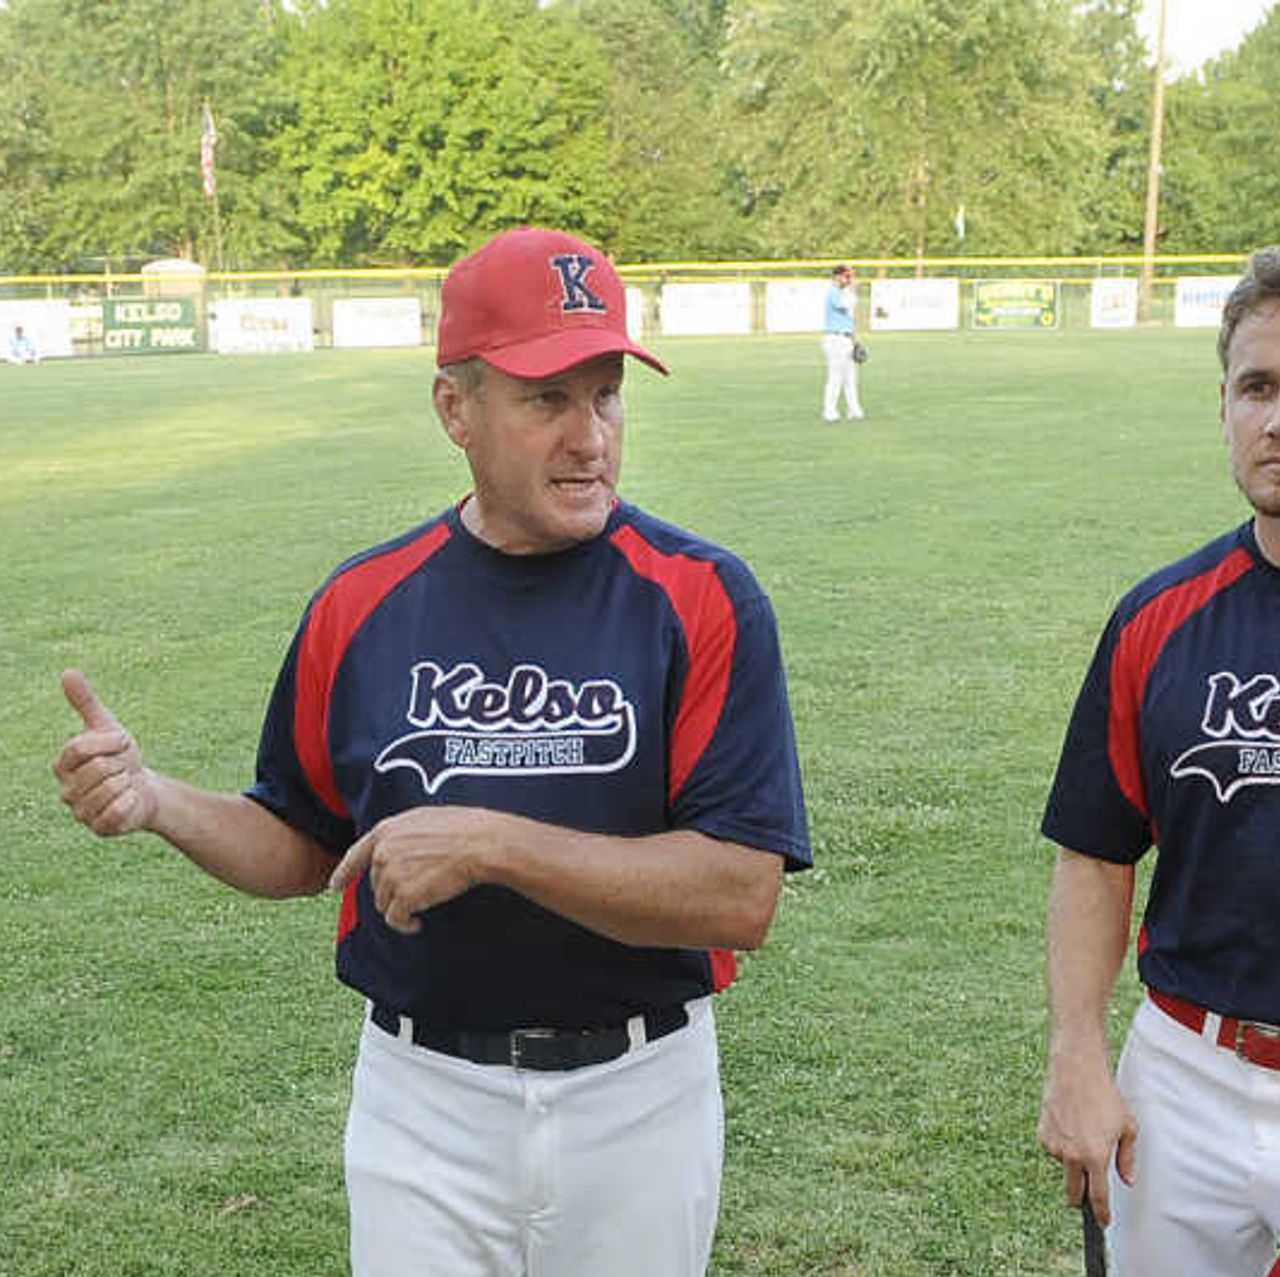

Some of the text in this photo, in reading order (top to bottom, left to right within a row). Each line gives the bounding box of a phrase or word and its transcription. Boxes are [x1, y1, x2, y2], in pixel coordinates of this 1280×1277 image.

[549, 254, 607, 314] K
[407, 661, 626, 731] Kelso
[444, 738, 584, 767] FASTPITCH
